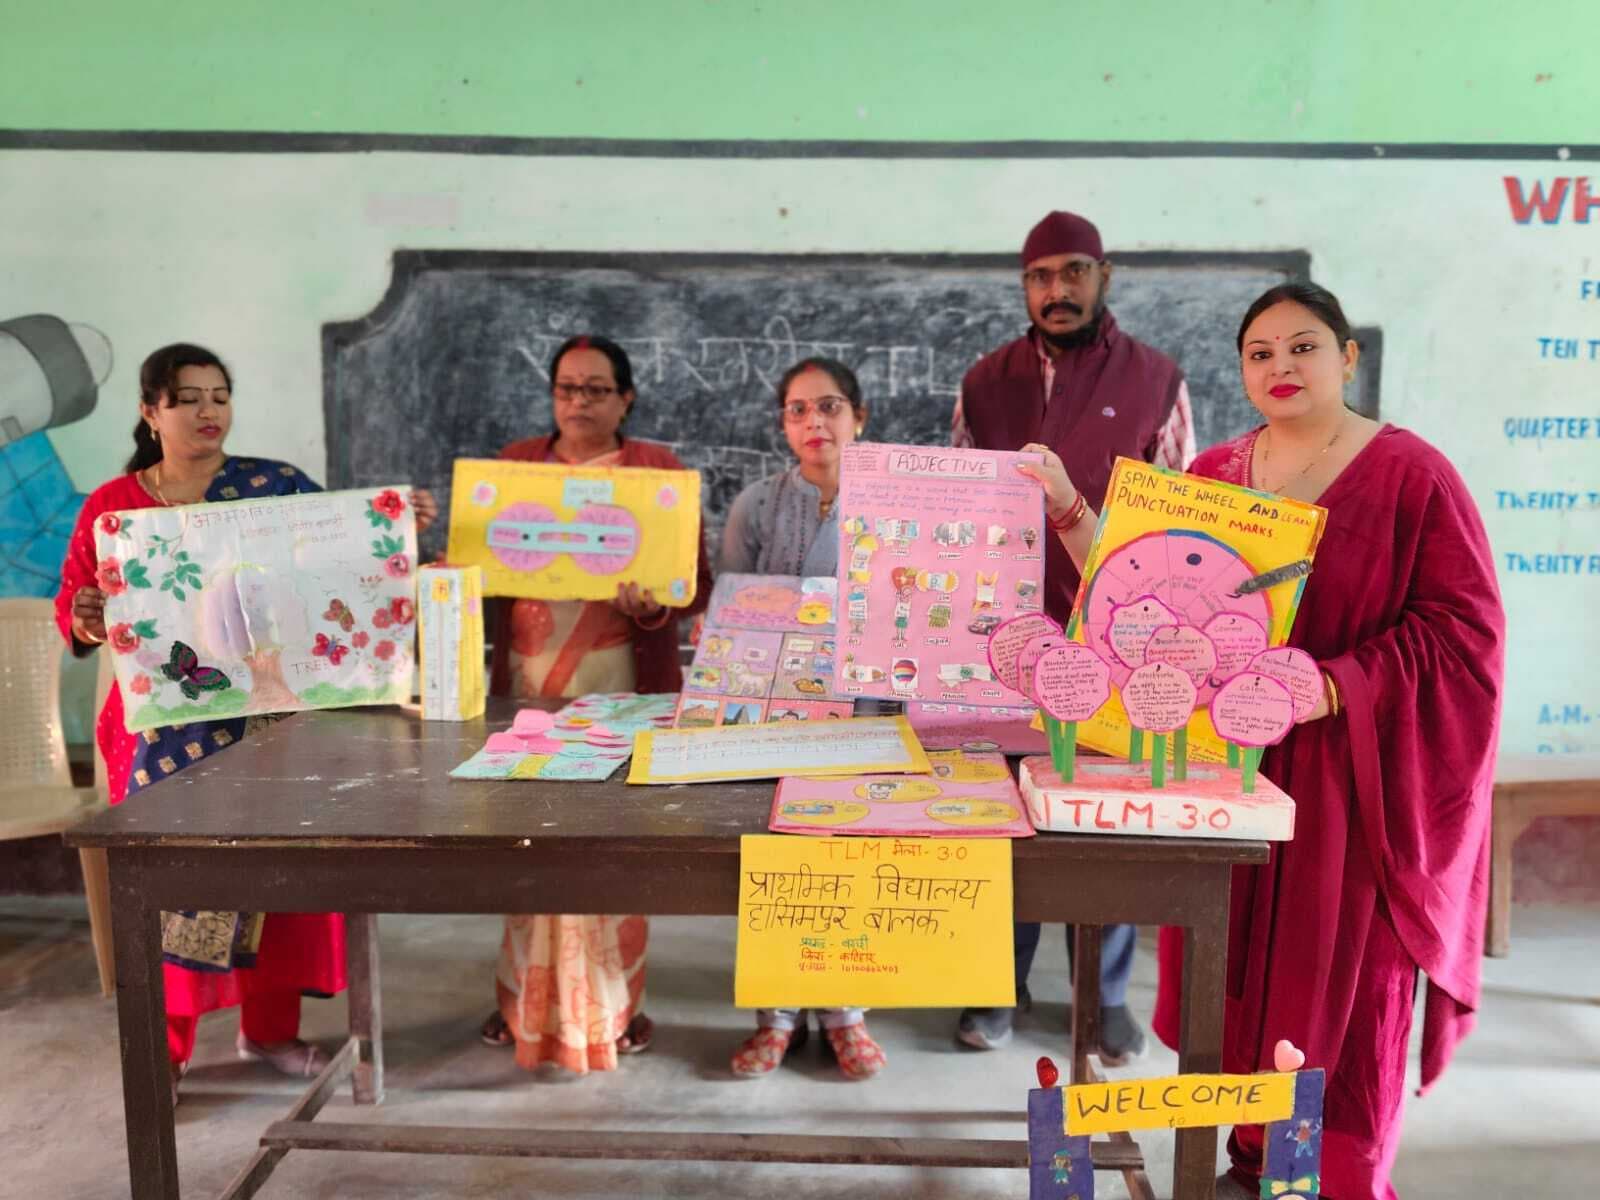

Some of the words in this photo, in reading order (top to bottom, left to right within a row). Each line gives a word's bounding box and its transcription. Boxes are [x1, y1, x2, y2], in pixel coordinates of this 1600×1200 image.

[1537, 338, 1577, 358] TEN
[897, 453, 991, 474] ADJECTIVE
[1121, 471, 1158, 489] SPIN
[1167, 480, 1188, 496] THE
[1195, 489, 1238, 510] WHEEL
[1248, 503, 1278, 519] AND
[1497, 490, 1577, 510] TWENTY
[1116, 487, 1219, 524] PUNCTUATION
[1228, 520, 1272, 537] MARKS
[1506, 554, 1583, 574] TWENTY
[820, 841, 881, 860] TLM
[746, 863, 855, 900] प्राथमिक
[745, 896, 856, 933] हासिमपुर
[1076, 1083, 1268, 1118] WELCOME
[1167, 1116, 1186, 1128] to
